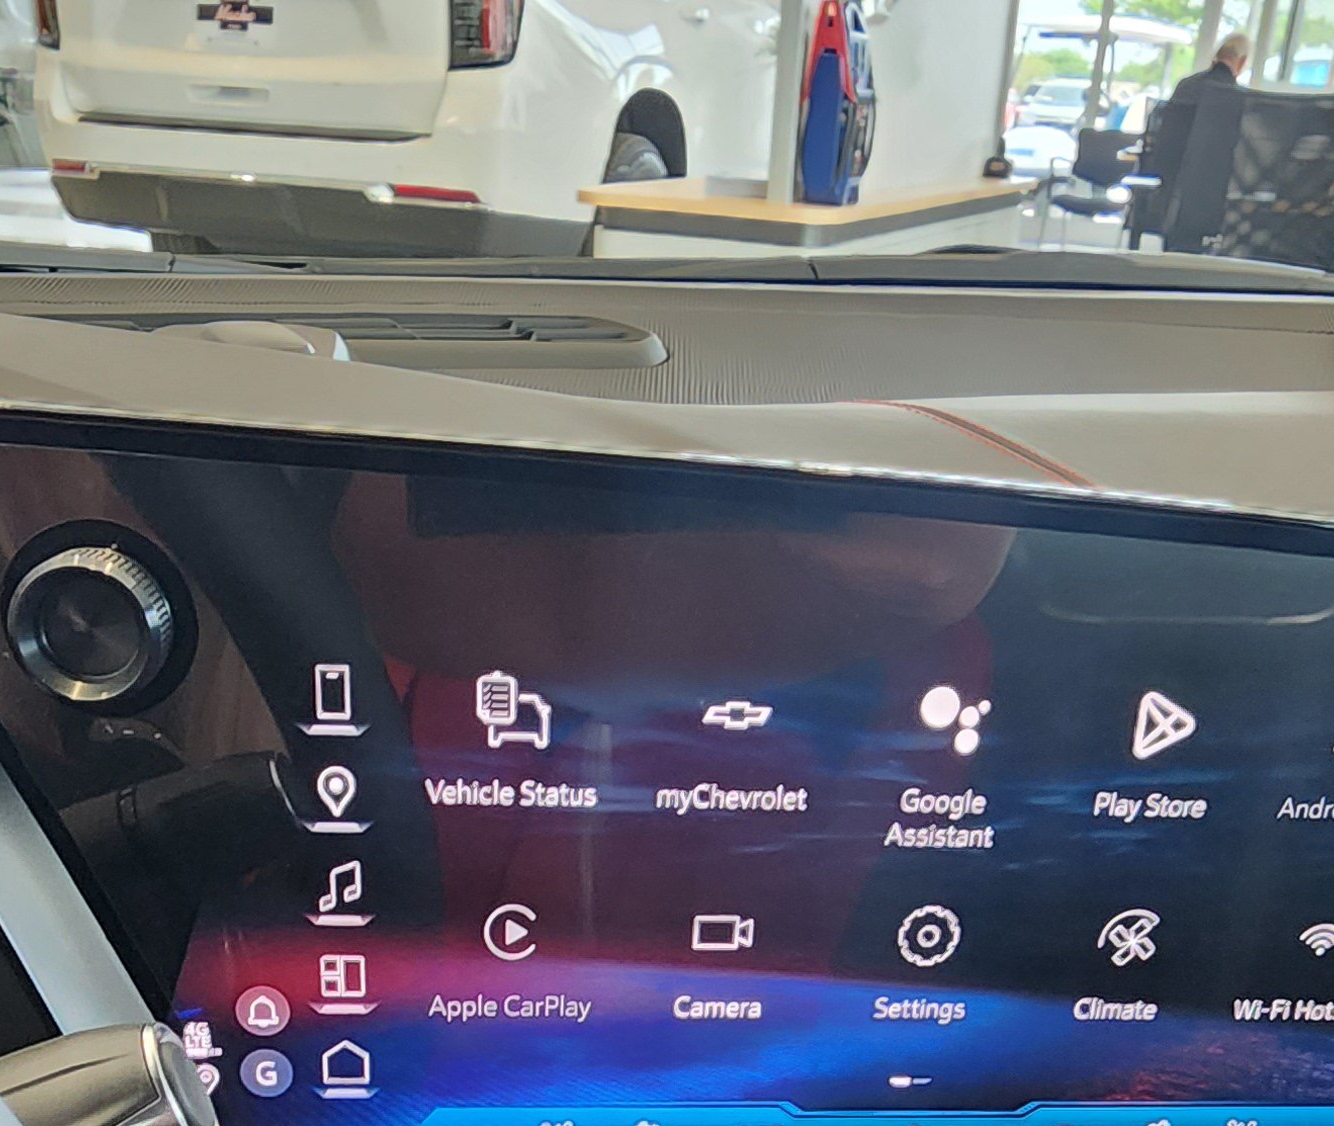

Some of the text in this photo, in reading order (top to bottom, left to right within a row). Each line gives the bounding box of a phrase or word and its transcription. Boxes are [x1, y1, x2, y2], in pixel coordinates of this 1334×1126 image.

[424, 778, 598, 808] Vehicle Status
[655, 783, 808, 816] myChevrolet
[899, 788, 988, 821] Google
[1093, 791, 1208, 824] Play Store
[883, 821, 995, 849] Assistant
[427, 994, 593, 1024] Apple CarPlay
[673, 995, 763, 1020] Camera
[872, 996, 966, 1025] Settings
[1073, 997, 1159, 1021] Climate
[1233, 998, 1292, 1021] Wi-Fi
[255, 1061, 278, 1087] G
